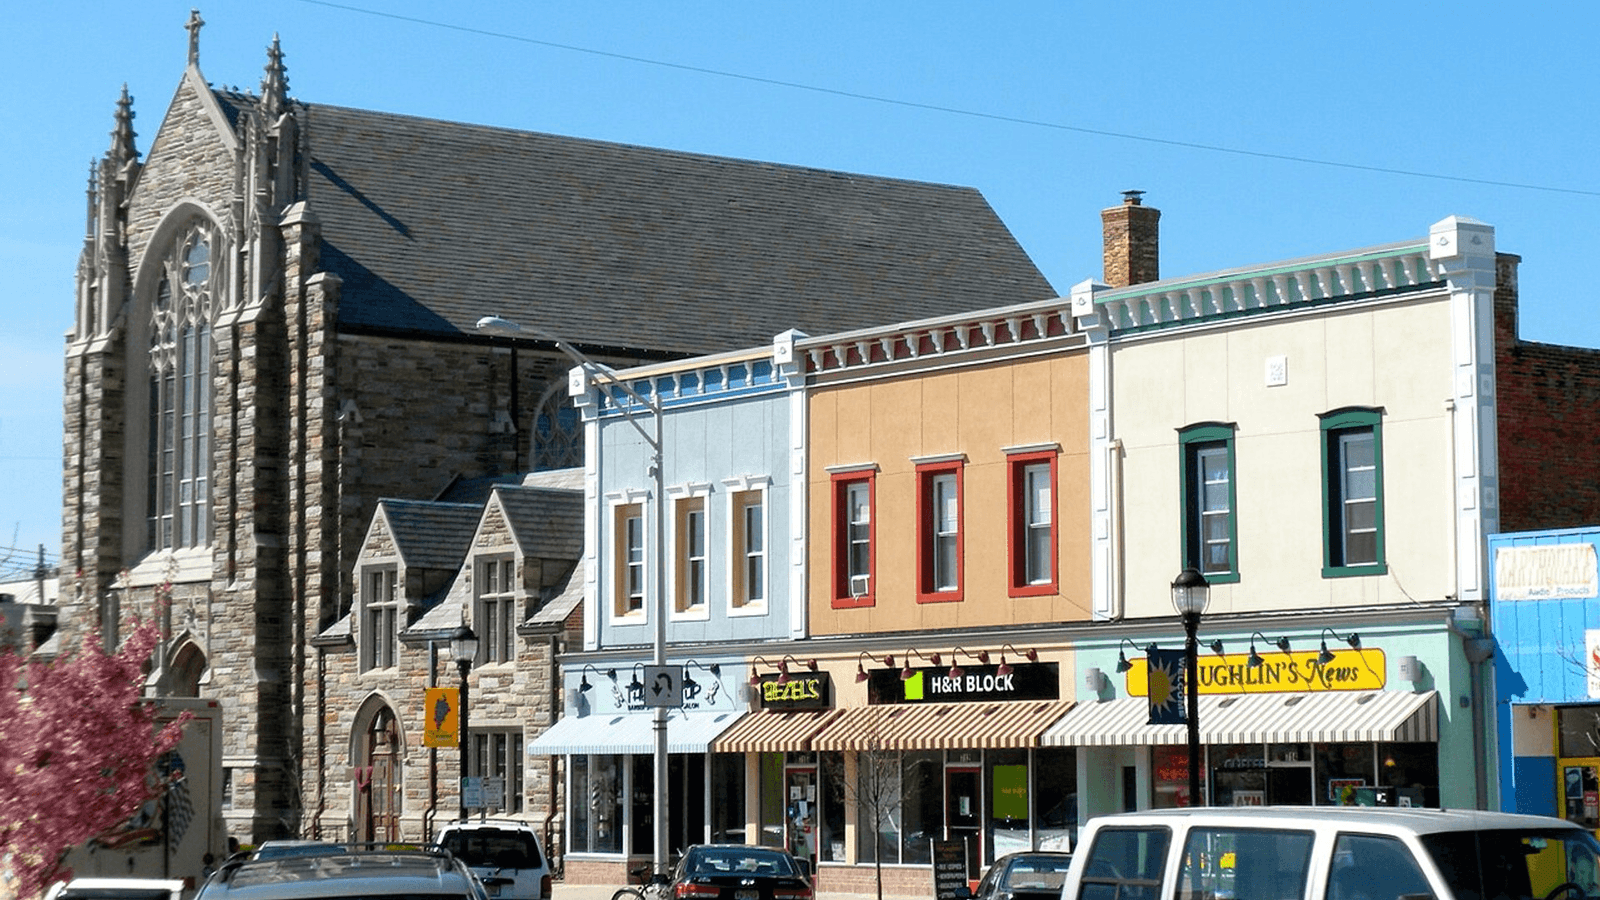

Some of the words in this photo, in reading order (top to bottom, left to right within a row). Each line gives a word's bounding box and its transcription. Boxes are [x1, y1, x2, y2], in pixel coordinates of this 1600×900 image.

[931, 676, 962, 694] H&R
[966, 673, 1014, 693] BLOCK
[1197, 661, 1299, 688] UGHLIN'S
[1305, 658, 1359, 689] News
